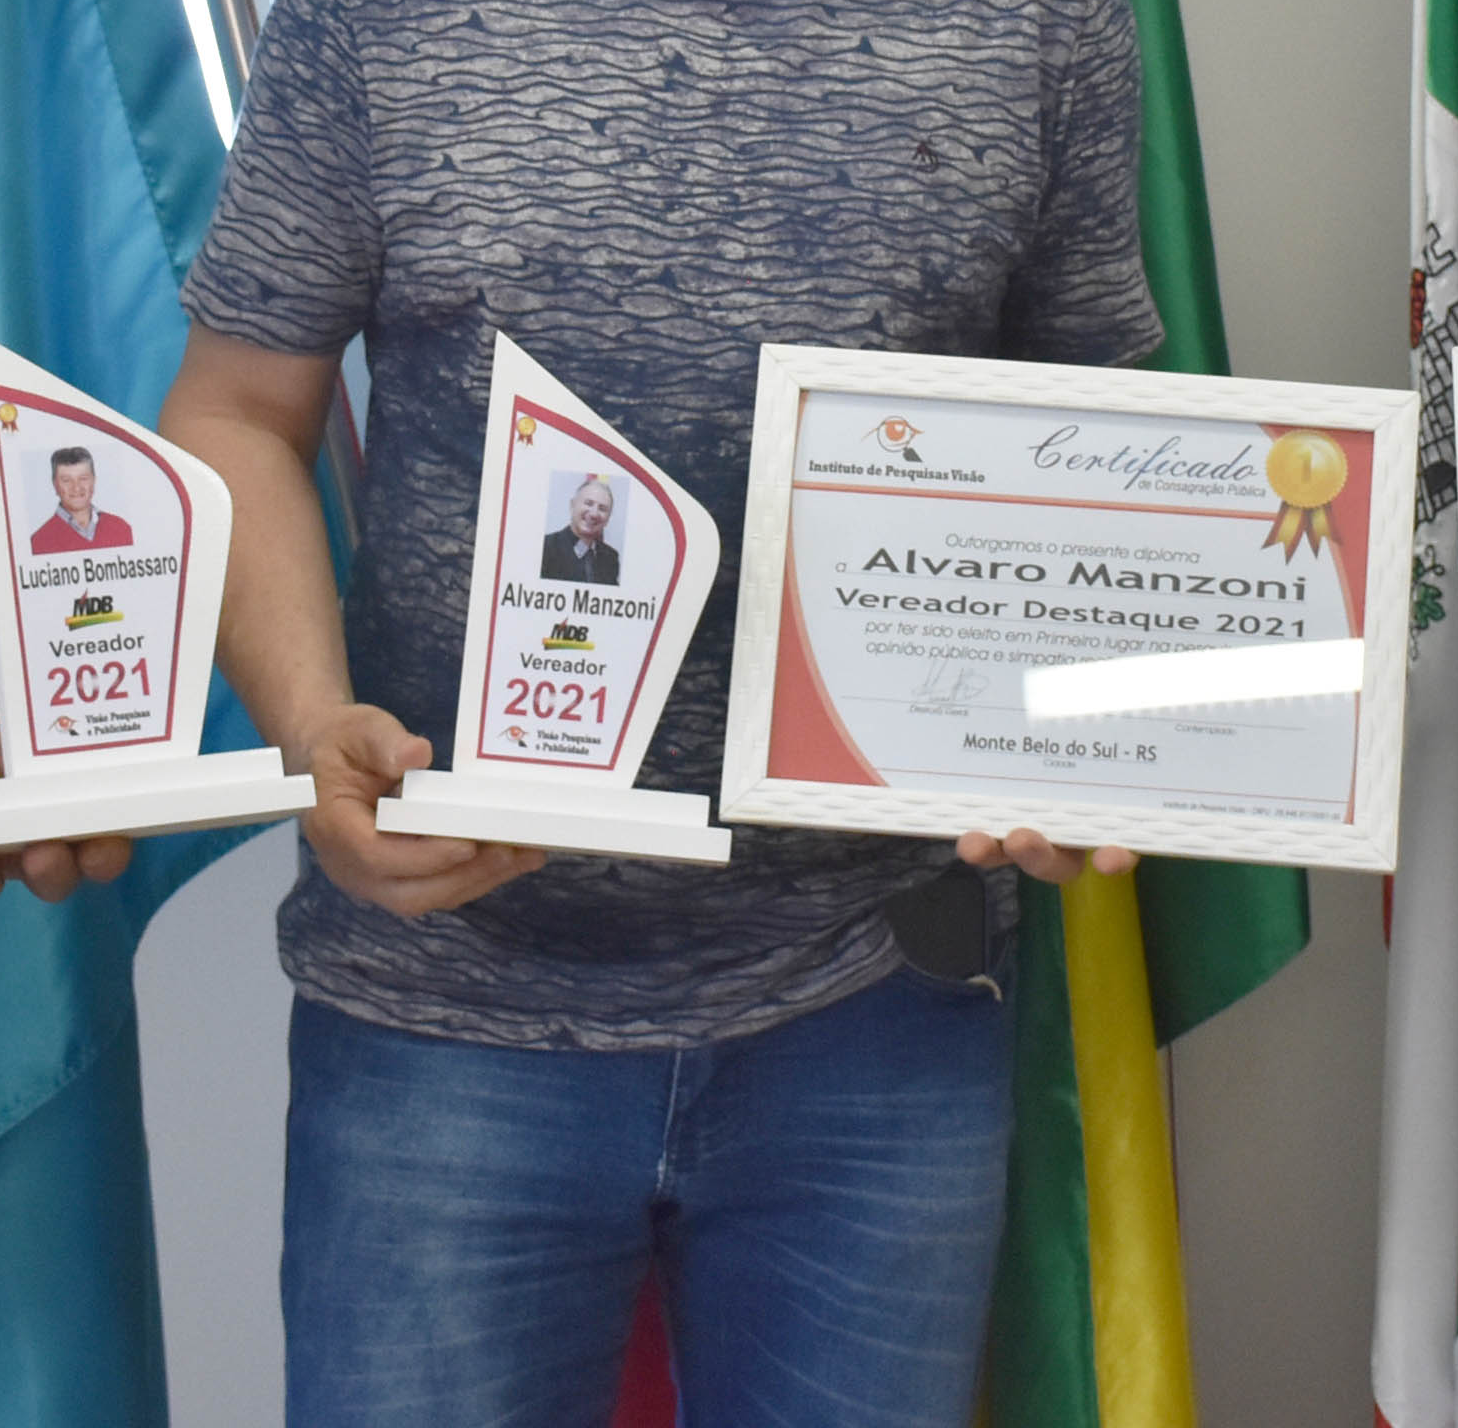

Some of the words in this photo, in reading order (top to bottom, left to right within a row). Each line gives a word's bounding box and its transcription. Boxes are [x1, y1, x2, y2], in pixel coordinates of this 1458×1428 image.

[809, 460, 863, 476] Instituto
[866, 463, 882, 476] de
[885, 465, 949, 482] Pesquisas
[951, 468, 985, 483] Visão
[1028, 424, 1258, 491] Certificado
[1138, 478, 1152, 490] de
[1155, 479, 1224, 497] Consagração
[1227, 481, 1266, 497] Pública
[945, 533, 1042, 555] Outorgamos
[1046, 542, 1058, 553] o
[1061, 542, 1129, 560] presente
[1134, 545, 1200, 565] diploma
[19, 562, 80, 589] Luciano
[83, 555, 178, 584] Bombassaro
[835, 562, 847, 573] a
[862, 547, 1047, 582] Alvaro
[1068, 561, 1306, 601] Manzoni
[72, 595, 114, 618] MDB
[501, 582, 566, 612] Alvaro
[572, 588, 656, 620] Manzoni
[835, 587, 1009, 617] Vereador
[1024, 599, 1200, 632] Destaque
[1215, 613, 1305, 638] 2021
[49, 634, 145, 658] Vereador
[551, 623, 589, 642] MDB
[865, 621, 893, 635] por
[896, 621, 918, 635] ter
[922, 623, 954, 638] sido
[957, 626, 1001, 642] eleito
[1005, 632, 1032, 644] em
[1036, 630, 1100, 650] Primeiro
[1103, 632, 1145, 653] lugar
[1149, 640, 1171, 653] na
[520, 652, 607, 677] Vereador
[865, 641, 925, 657] opinião
[928, 643, 988, 661] pública
[993, 651, 1004, 662] e
[1008, 648, 1076, 668] simpatia
[47, 657, 150, 707] 2021
[504, 677, 607, 724] 2021
[963, 732, 1017, 752] Monte
[1022, 736, 1060, 755] Belo
[1065, 739, 1087, 756] do
[1093, 740, 1118, 760] Sul
[1136, 744, 1157, 762] RS
